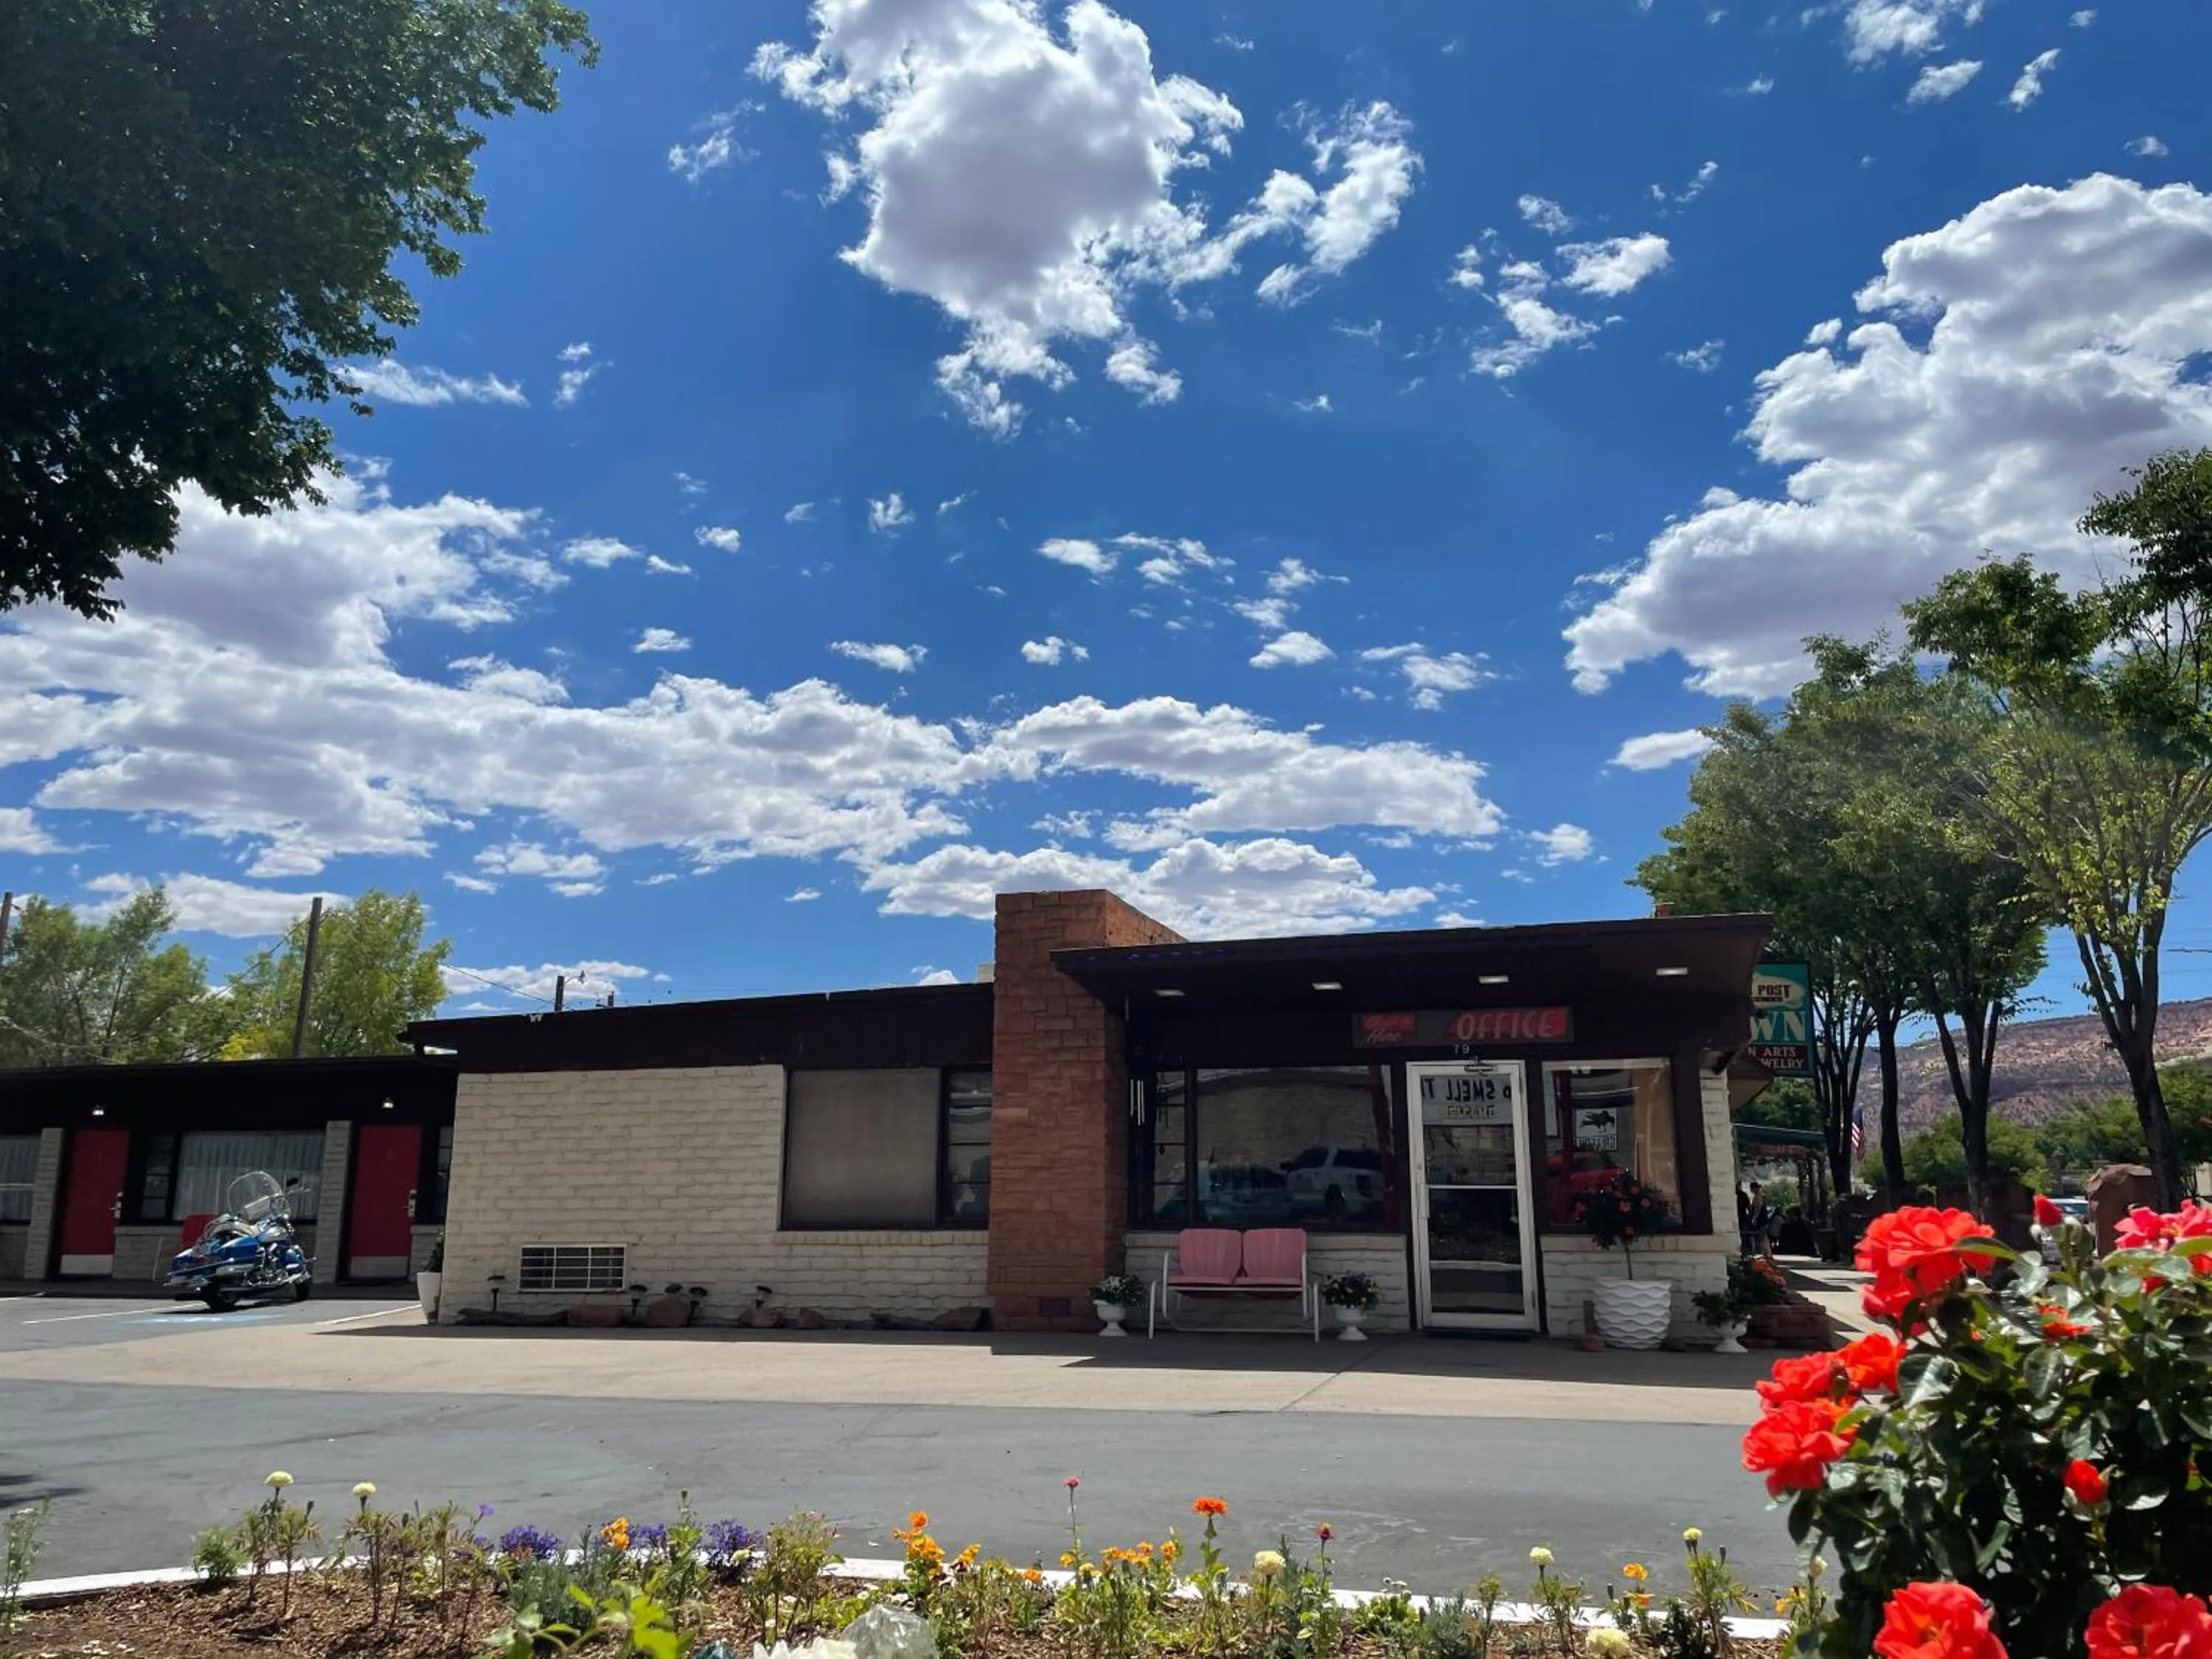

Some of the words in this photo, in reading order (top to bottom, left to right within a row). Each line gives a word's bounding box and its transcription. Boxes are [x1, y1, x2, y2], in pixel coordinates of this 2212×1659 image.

[1758, 985, 1792, 998] POST
[1457, 1010, 1557, 1040] OFFICE
[1761, 1046, 1797, 1057] ARTS
[1759, 1058, 1804, 1069] WELRY
